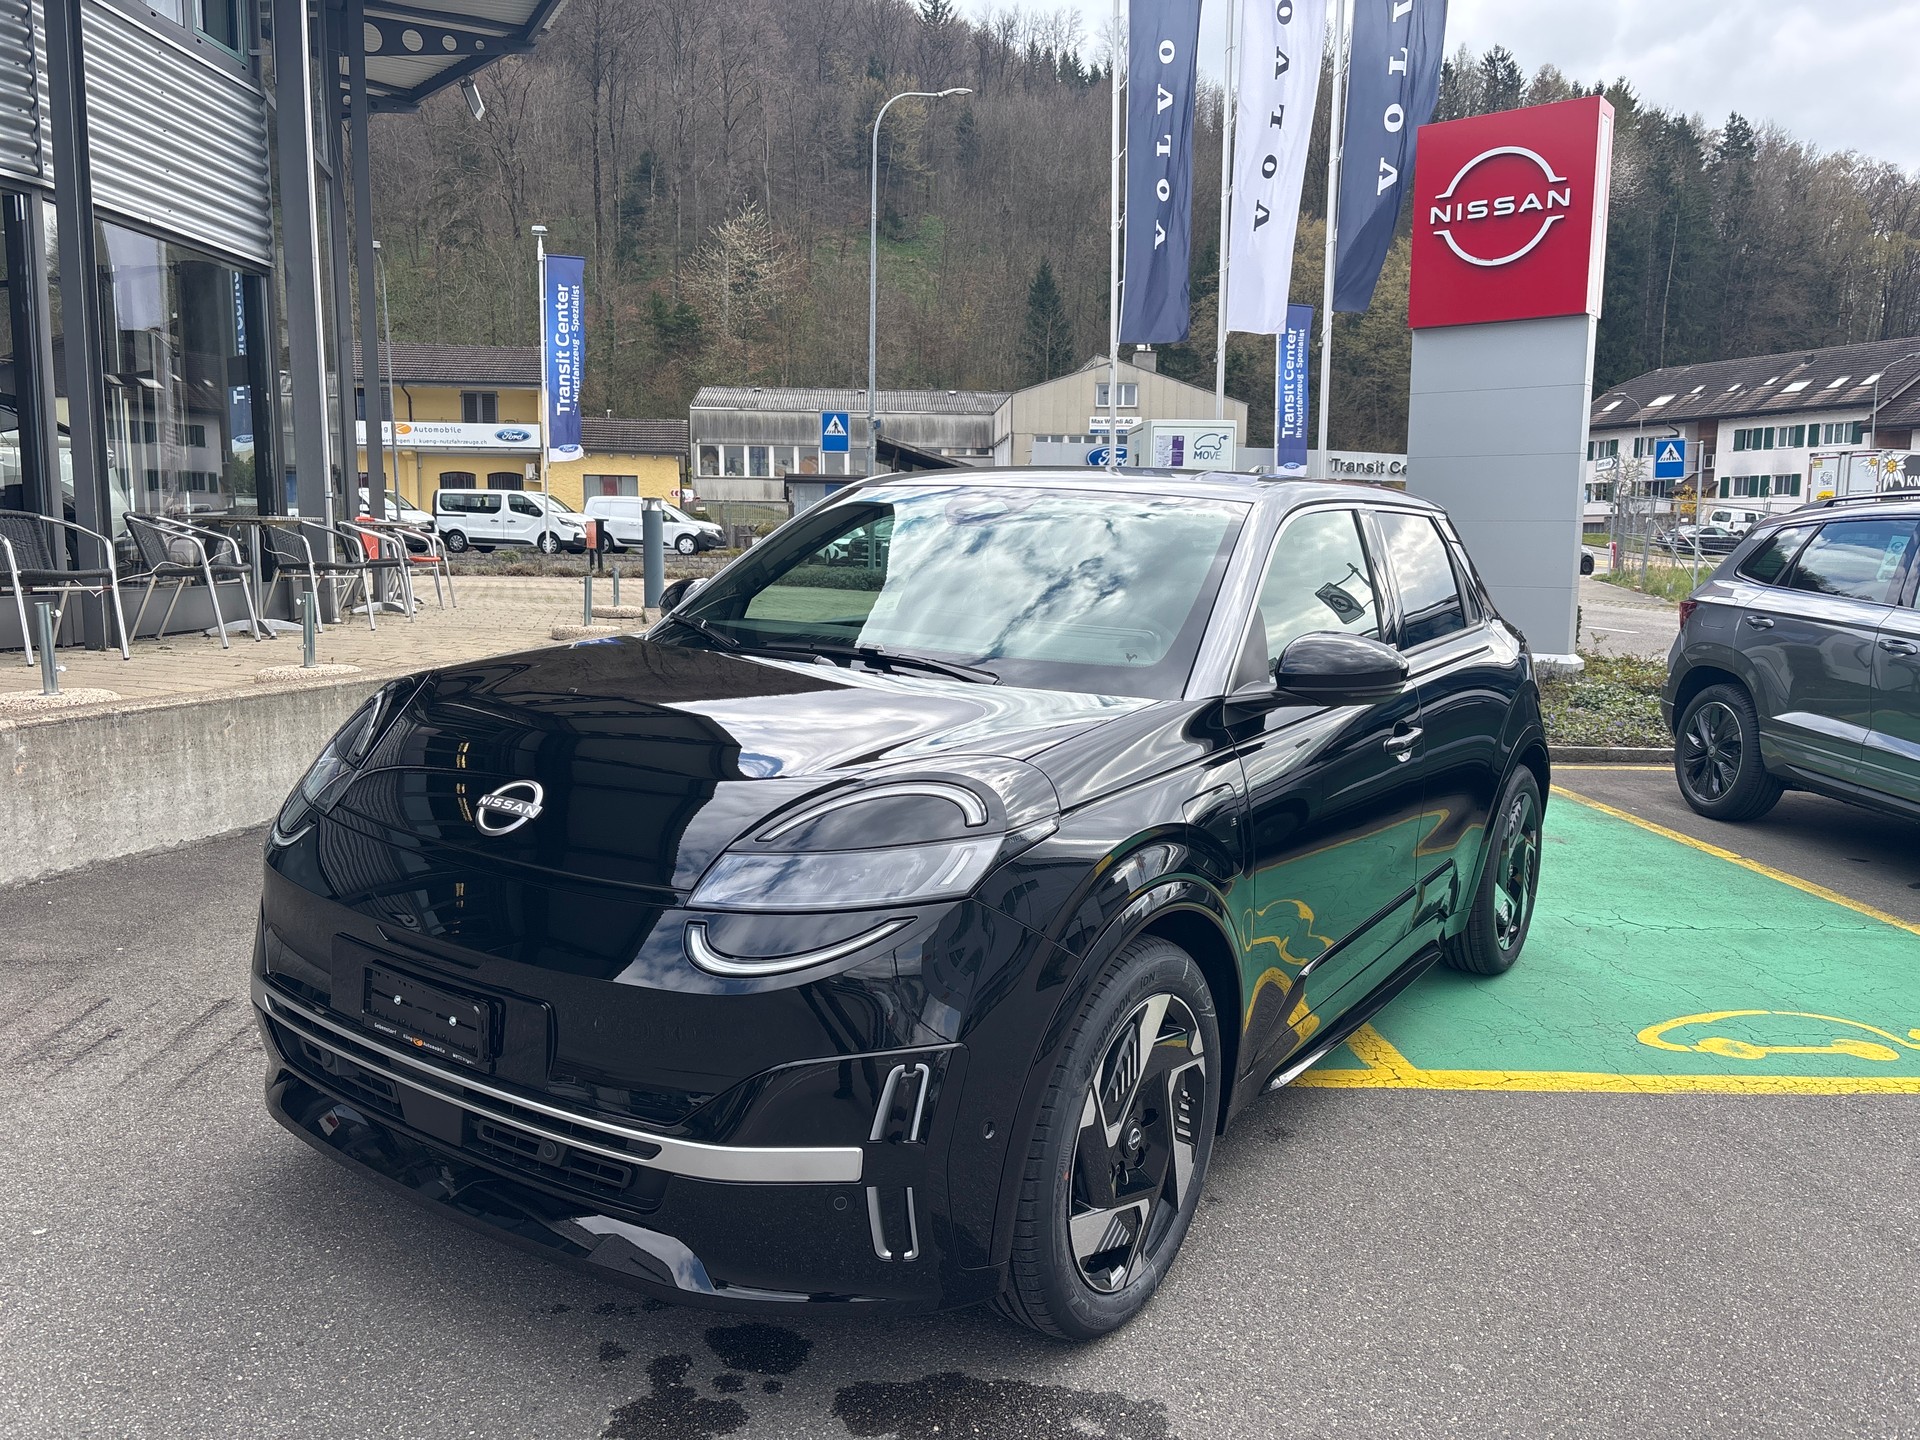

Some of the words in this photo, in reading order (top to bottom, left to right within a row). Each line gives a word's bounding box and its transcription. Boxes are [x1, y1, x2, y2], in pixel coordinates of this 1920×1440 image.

[1253, 0, 1293, 232] VOLVO
[1154, 39, 1175, 250] VOLVO
[1429, 188, 1571, 225] NISSAN
[555, 283, 570, 347] Center
[571, 285, 580, 332] Spezialist
[1284, 327, 1297, 381] Center
[555, 351, 570, 416] Transit
[413, 426, 462, 434] Automobile
[1282, 383, 1294, 439] Transit
[1193, 450, 1222, 461] MOVE
[1330, 457, 1385, 475] Transit
[478, 795, 540, 817] NISSAN
